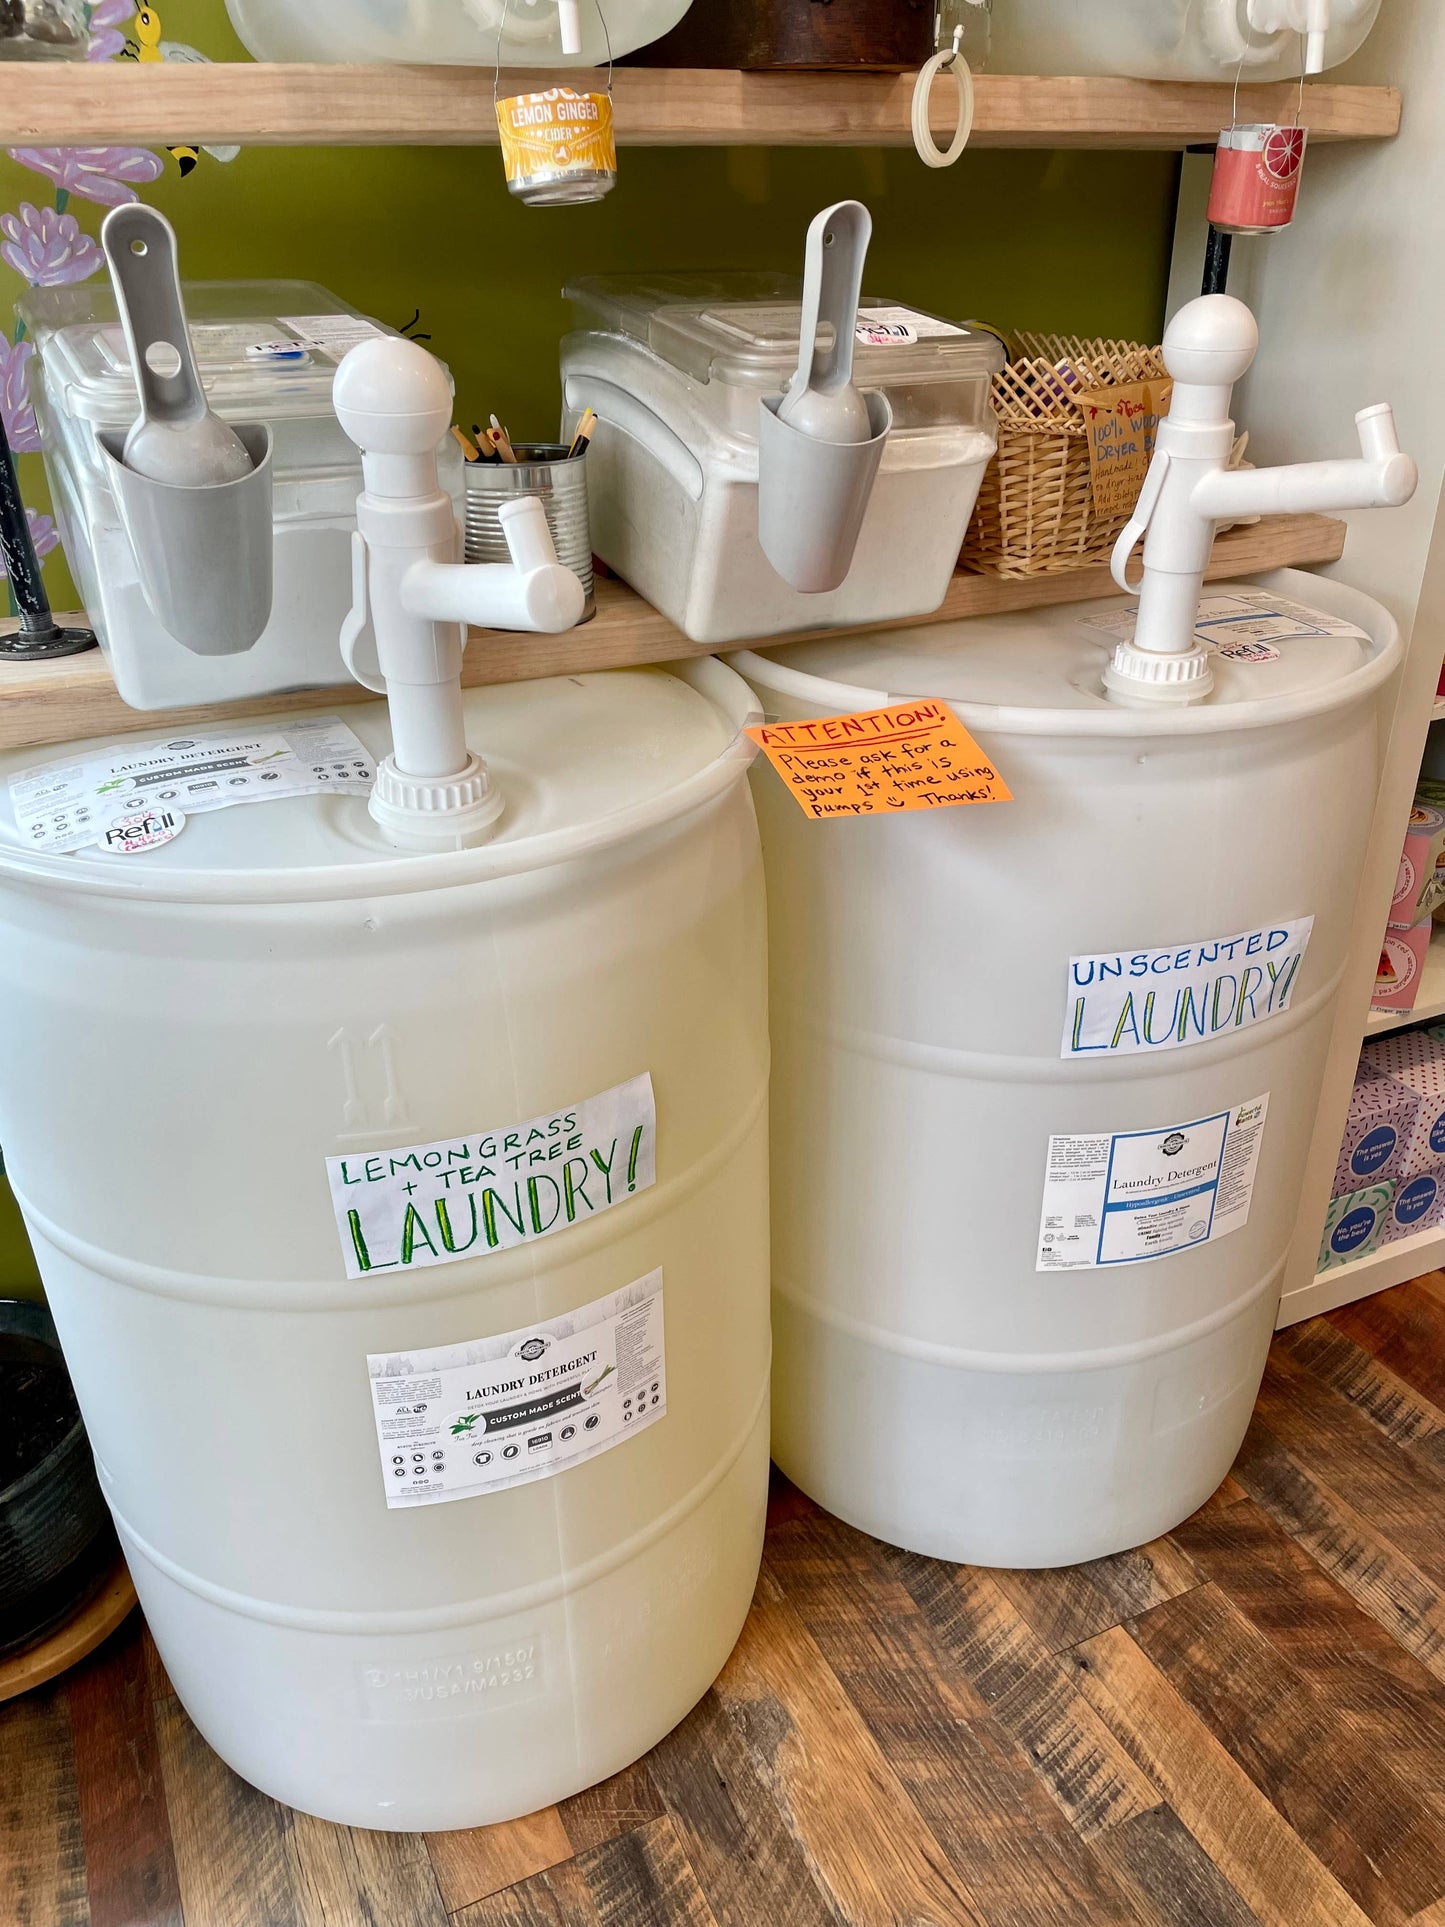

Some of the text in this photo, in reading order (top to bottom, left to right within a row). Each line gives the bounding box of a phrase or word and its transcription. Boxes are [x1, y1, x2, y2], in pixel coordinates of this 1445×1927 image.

[511, 102, 598, 127] LEMON GINGER
[544, 127, 572, 142] CIDER
[1097, 442, 1138, 462] DRYER
[761, 705, 946, 744] ATTENTION!
[110, 743, 262, 774] LAUNDRY DETERGENT
[779, 738, 957, 770] Please ask for a
[139, 759, 248, 783] CUSTOM MADE SCENT
[792, 756, 952, 784] demo if this is
[801, 765, 995, 802] your 1st time using
[812, 785, 996, 817] pumps Thanks!
[1072, 930, 1289, 986] UNSCENTED
[1071, 953, 1301, 1052] LAUNDRY!
[341, 1112, 577, 1185] LEMONGRASS
[435, 1165, 496, 1188] TEA
[505, 1133, 583, 1170] TREE
[1356, 1139, 1394, 1156] The answer
[1370, 1151, 1382, 1160] yes
[1113, 1175, 1164, 1190] Laundry
[1168, 1160, 1217, 1181] Detergent
[347, 1125, 643, 1272] LAUNDRY!
[1126, 1196, 1168, 1209] Hypoallergenic
[1174, 1187, 1201, 1199] Unscented
[1399, 1189, 1436, 1206] The answer
[1413, 1201, 1424, 1209] yes
[1351, 1227, 1367, 1237] best
[466, 1378, 525, 1400] LAUNDRY
[529, 1351, 597, 1385] DETERGENT
[490, 1391, 581, 1425] CUSTOM MADE SCENT
[500, 1394, 523, 1404] LAUNDRY
[484, 1435, 505, 1444] cleaning
